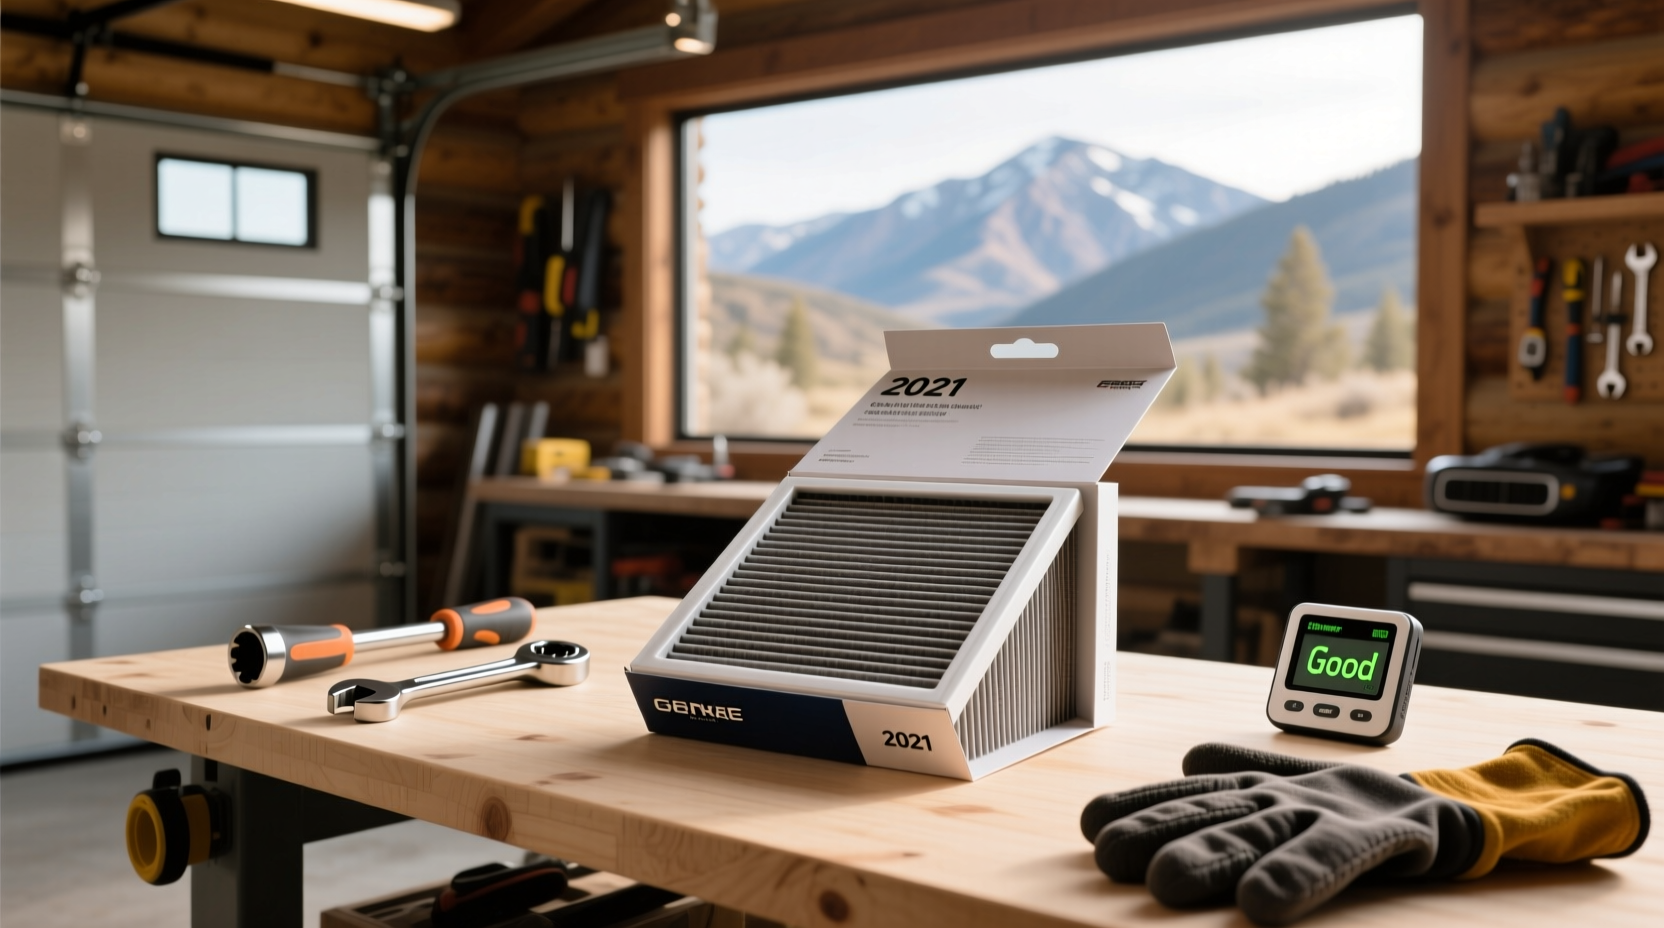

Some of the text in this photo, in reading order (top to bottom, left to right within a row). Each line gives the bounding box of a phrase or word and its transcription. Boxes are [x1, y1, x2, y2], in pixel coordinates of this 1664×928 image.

[880, 376, 968, 397] 2021
[1306, 645, 1379, 681] Good
[882, 730, 932, 752] 2021
